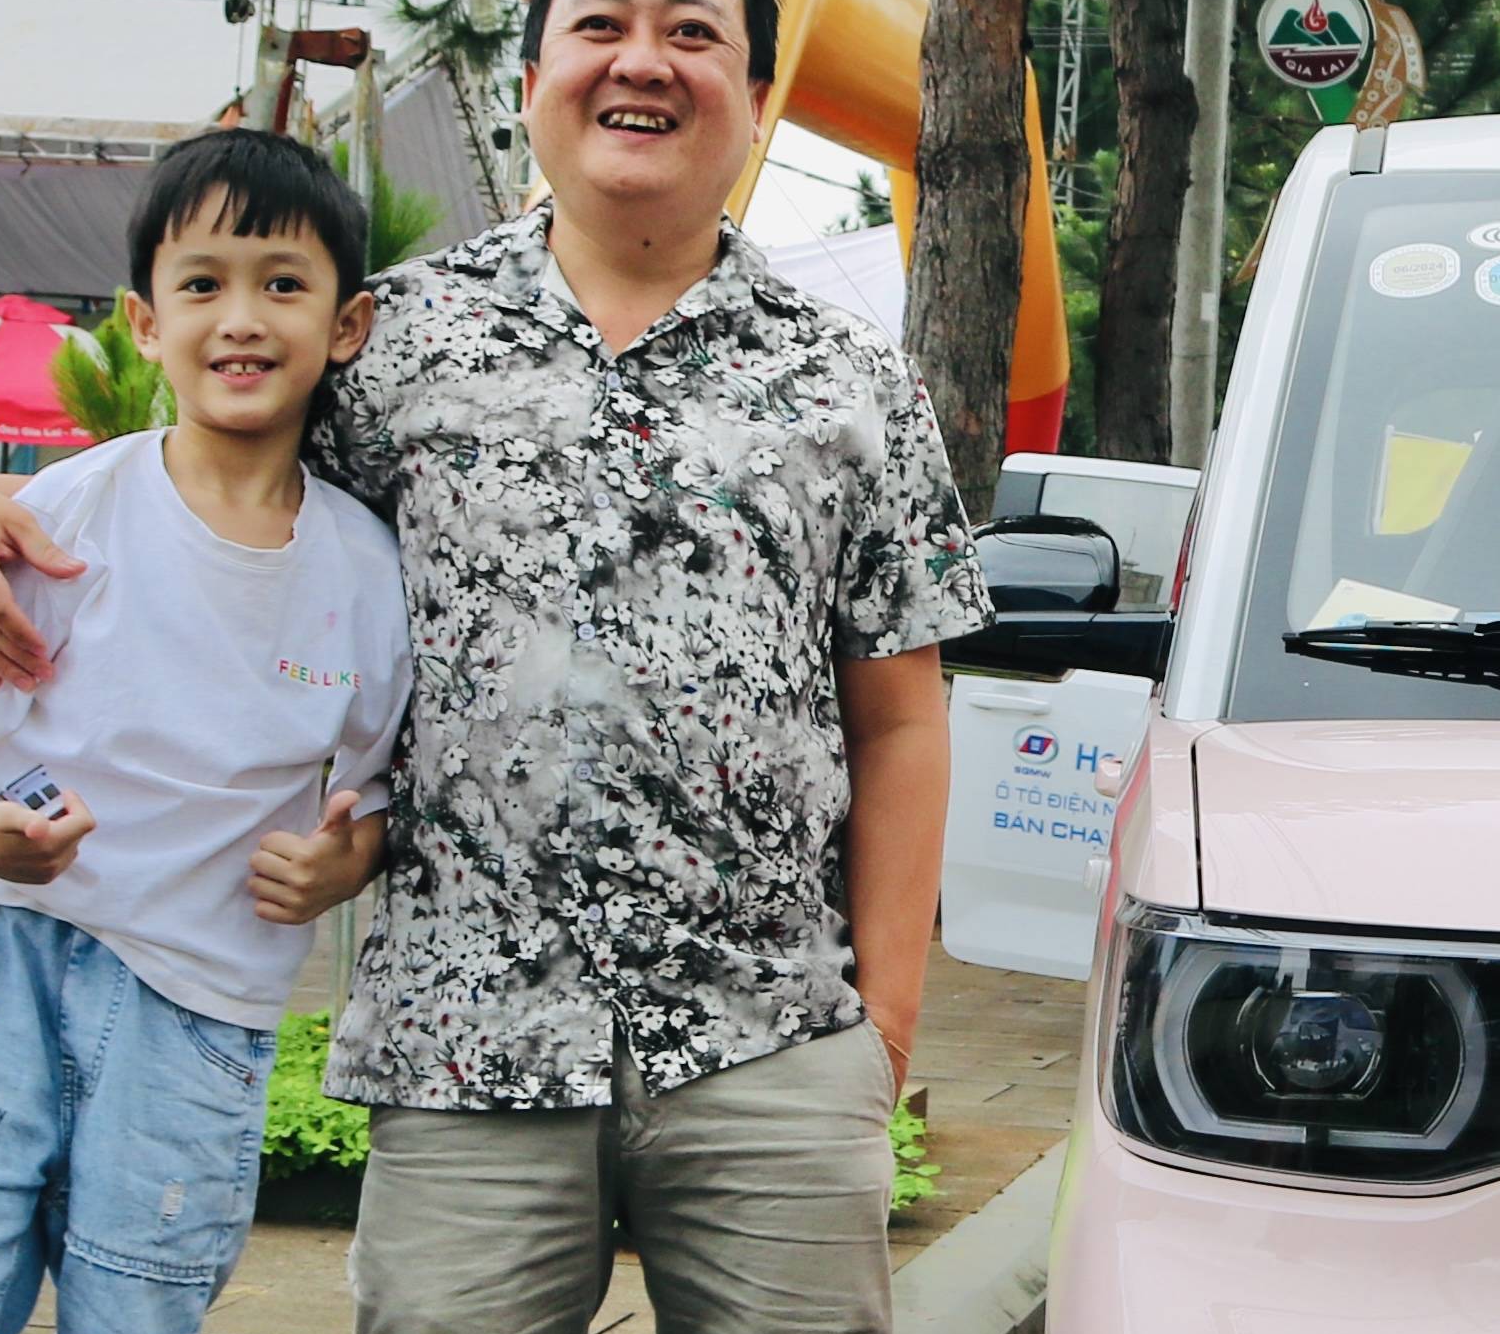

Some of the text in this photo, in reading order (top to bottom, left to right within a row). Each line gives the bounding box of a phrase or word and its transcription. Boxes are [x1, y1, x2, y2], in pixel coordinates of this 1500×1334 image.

[1285, 59, 1345, 76] GIA LAI
[279, 659, 361, 689] FEEL LIKE
[996, 779, 1010, 800] Ô
[1015, 786, 1042, 805] TÔ
[1047, 792, 1097, 816] ĐIỆN
[994, 810, 1110, 851] BÁN CHẠ
